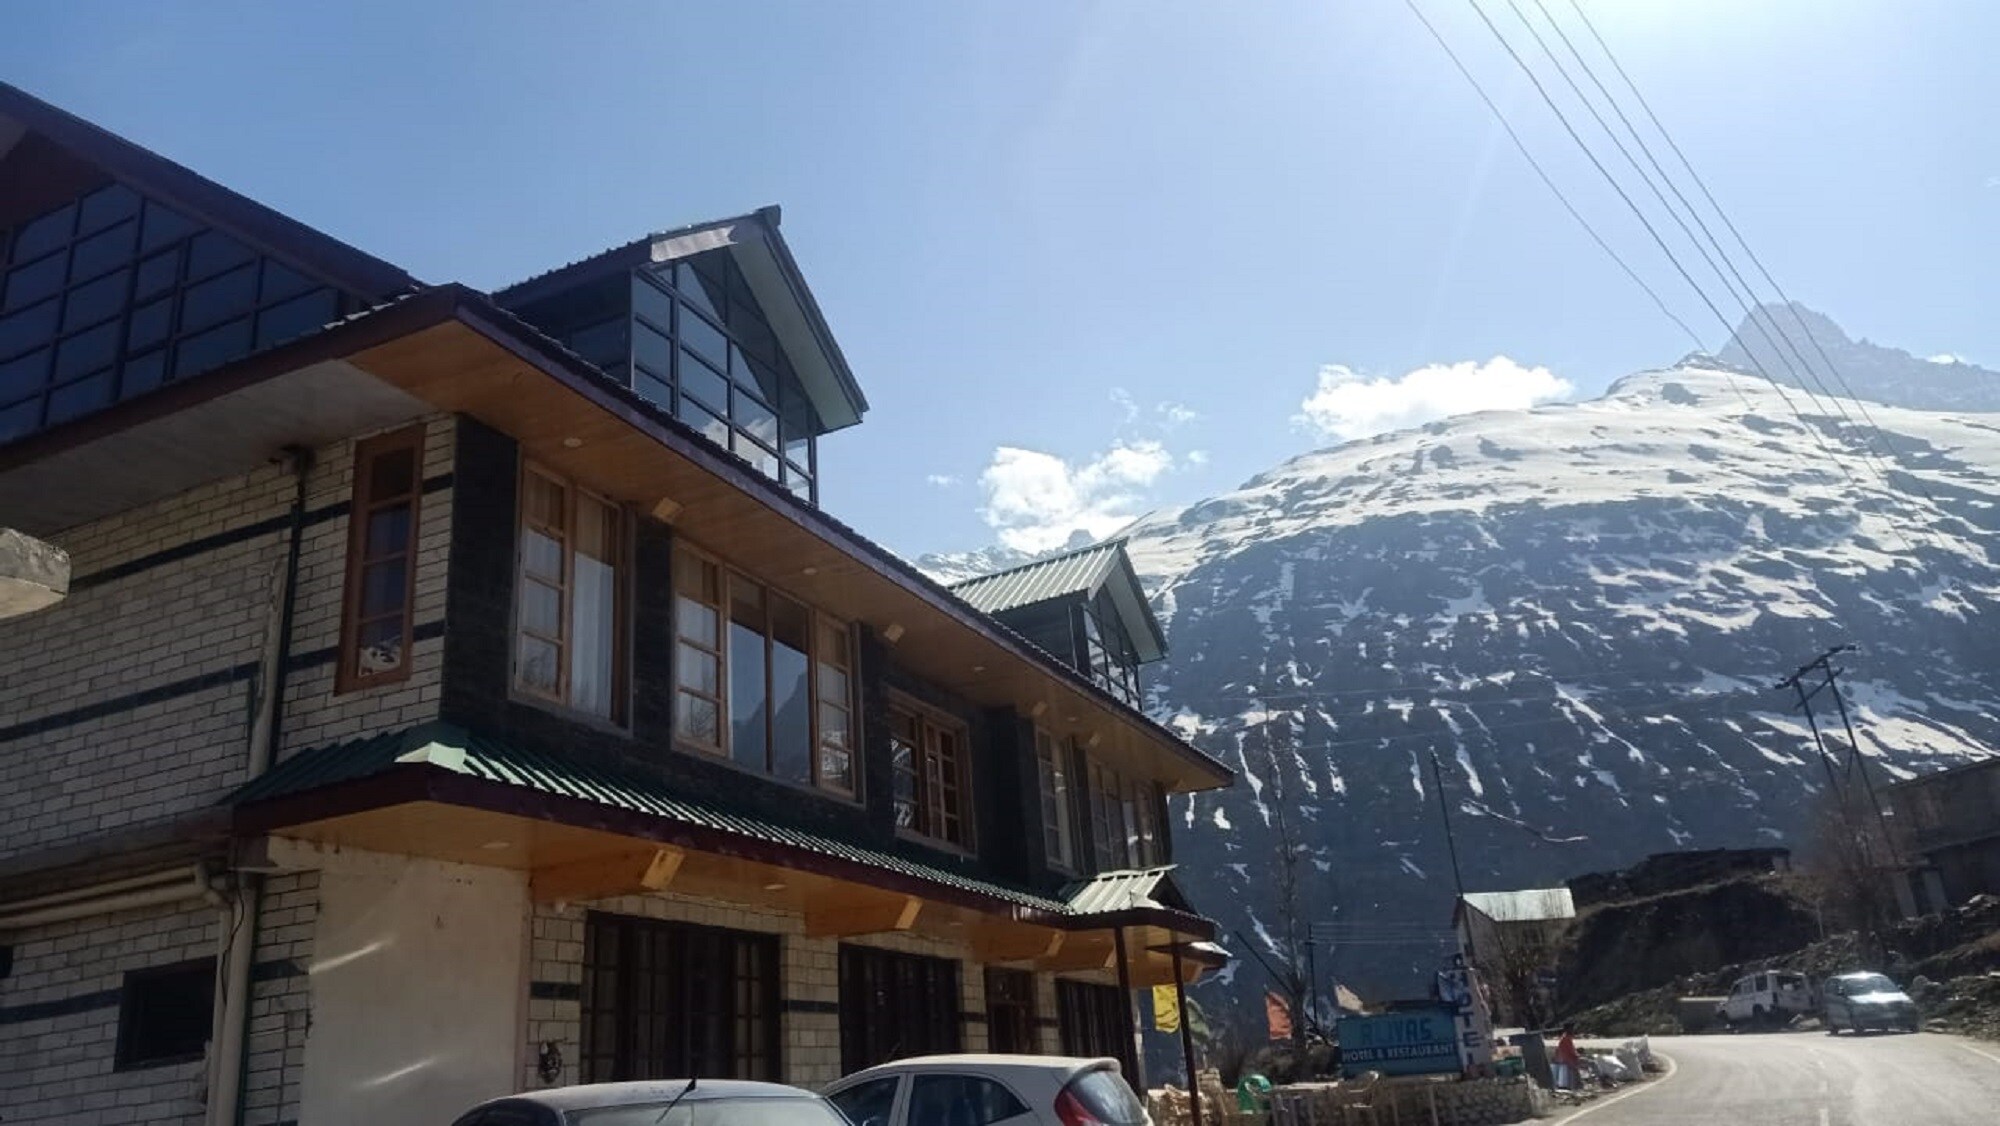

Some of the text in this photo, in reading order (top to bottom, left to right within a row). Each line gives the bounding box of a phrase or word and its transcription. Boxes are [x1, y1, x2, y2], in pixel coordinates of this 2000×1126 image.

[1342, 1044, 1453, 1062] HOTEL & RESTAURANT
